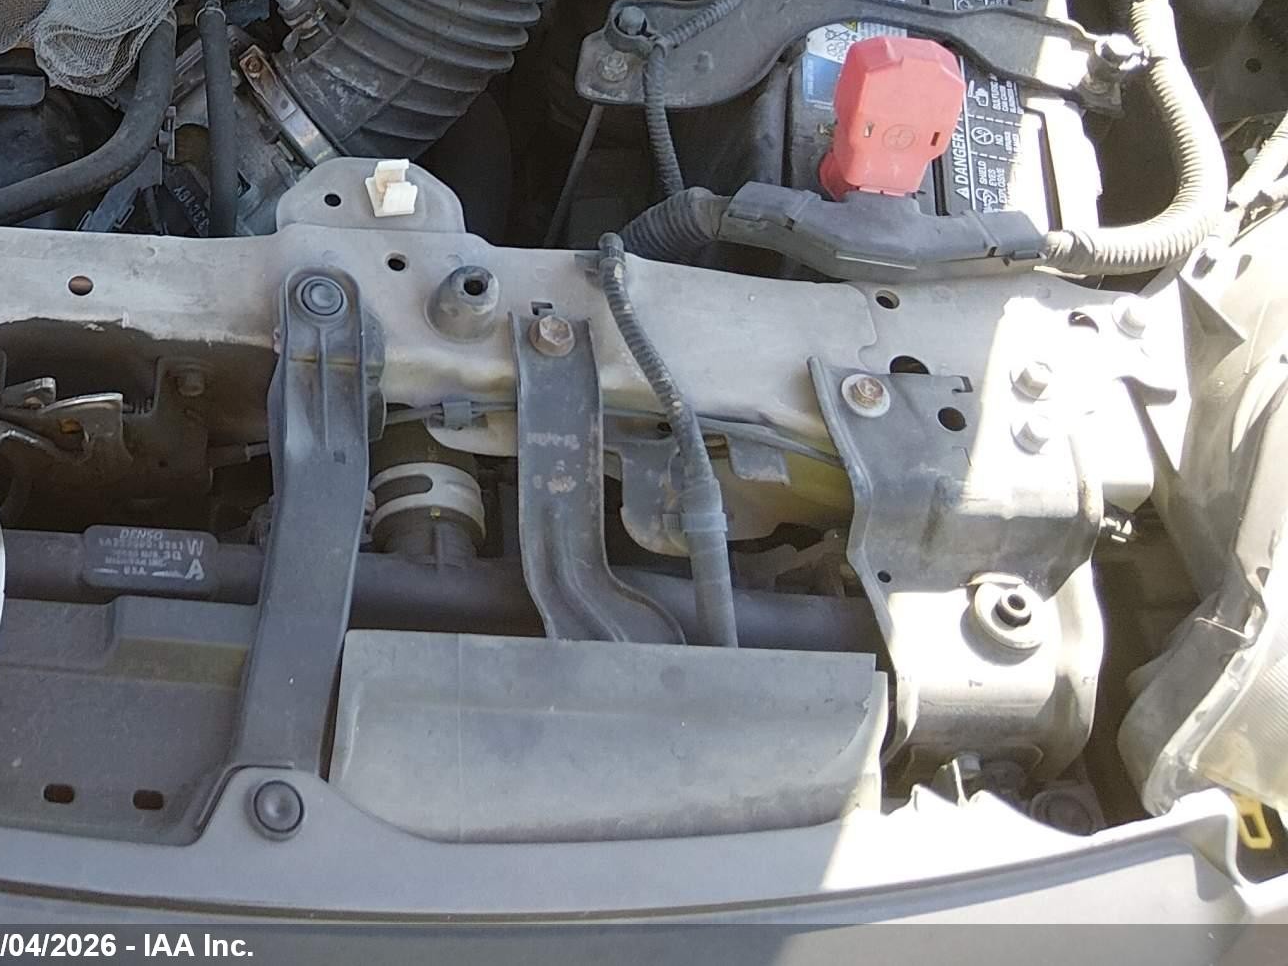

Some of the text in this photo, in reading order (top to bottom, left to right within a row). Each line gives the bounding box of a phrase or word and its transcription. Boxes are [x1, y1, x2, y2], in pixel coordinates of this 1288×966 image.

[990, 81, 1001, 111] SULFURIC
[994, 134, 1004, 146] NO
[952, 133, 968, 185] DANGER
[977, 160, 988, 184] SHIELD
[988, 169, 997, 186] EYES
[997, 167, 1006, 203] EXPLOSIVE
[119, 528, 163, 541] DENSO
[187, 538, 204, 556] W
[184, 558, 205, 580] A
